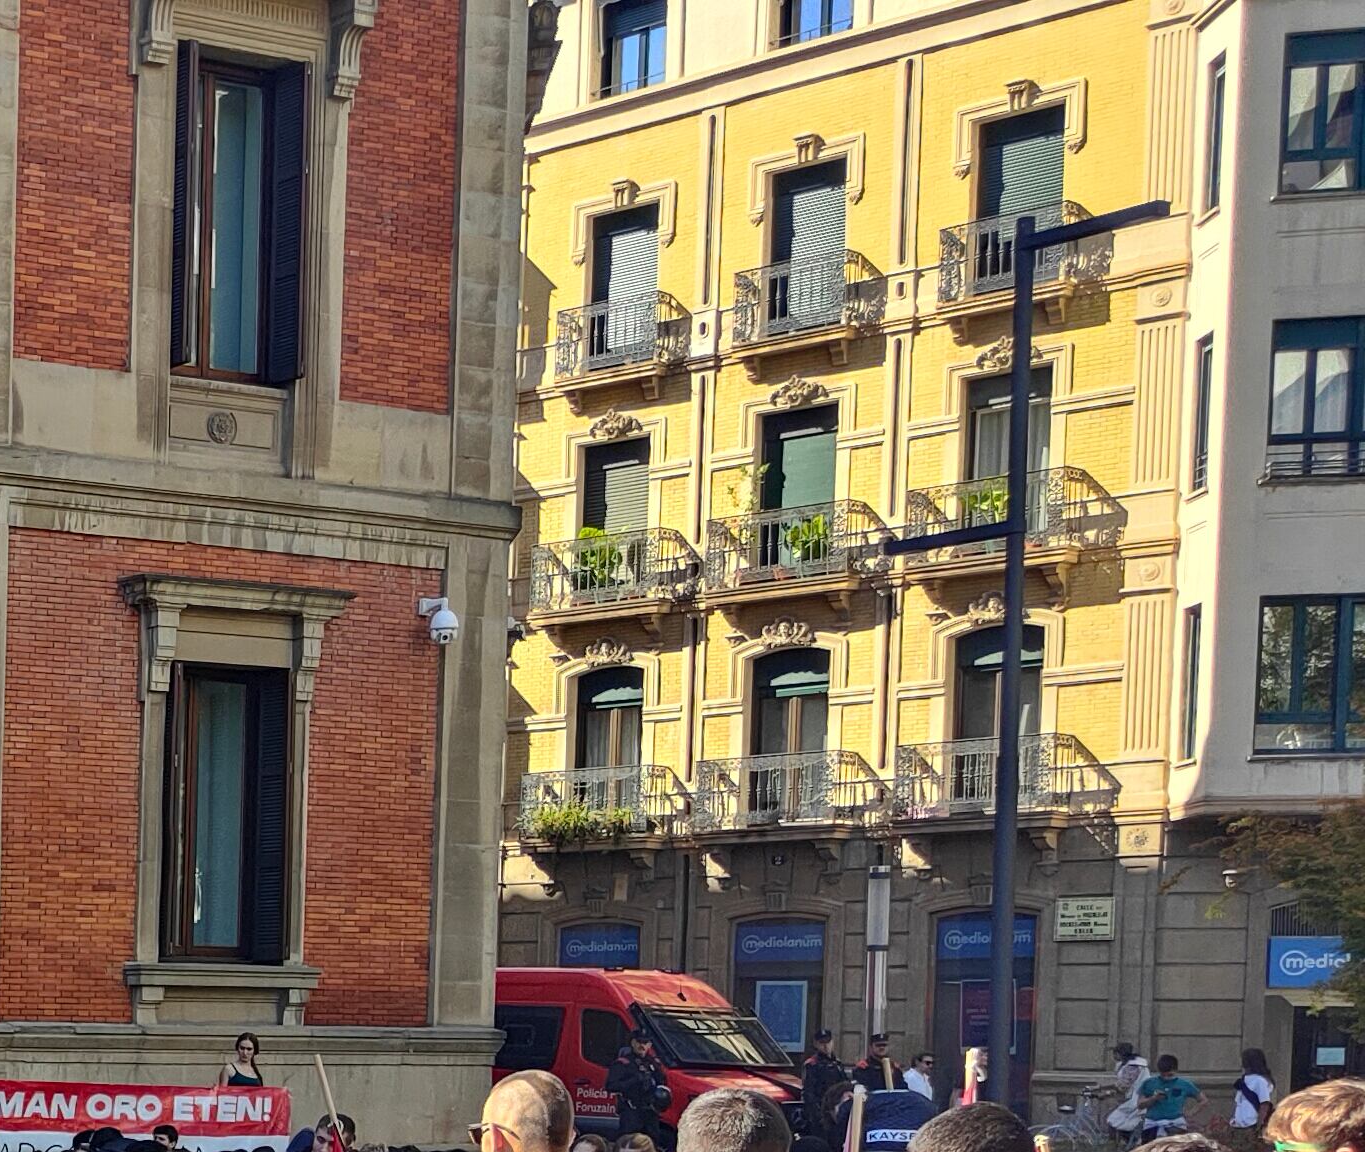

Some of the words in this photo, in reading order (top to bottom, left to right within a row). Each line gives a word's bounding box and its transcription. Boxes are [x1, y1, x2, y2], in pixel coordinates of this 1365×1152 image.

[566, 940, 638, 956] mediolanum
[742, 935, 823, 952] mediolanum
[576, 1087, 608, 1098] Policía
[86, 1093, 162, 1122] ORO
[172, 1095, 272, 1123] ETEN!
[575, 1102, 617, 1114] Foruzain
